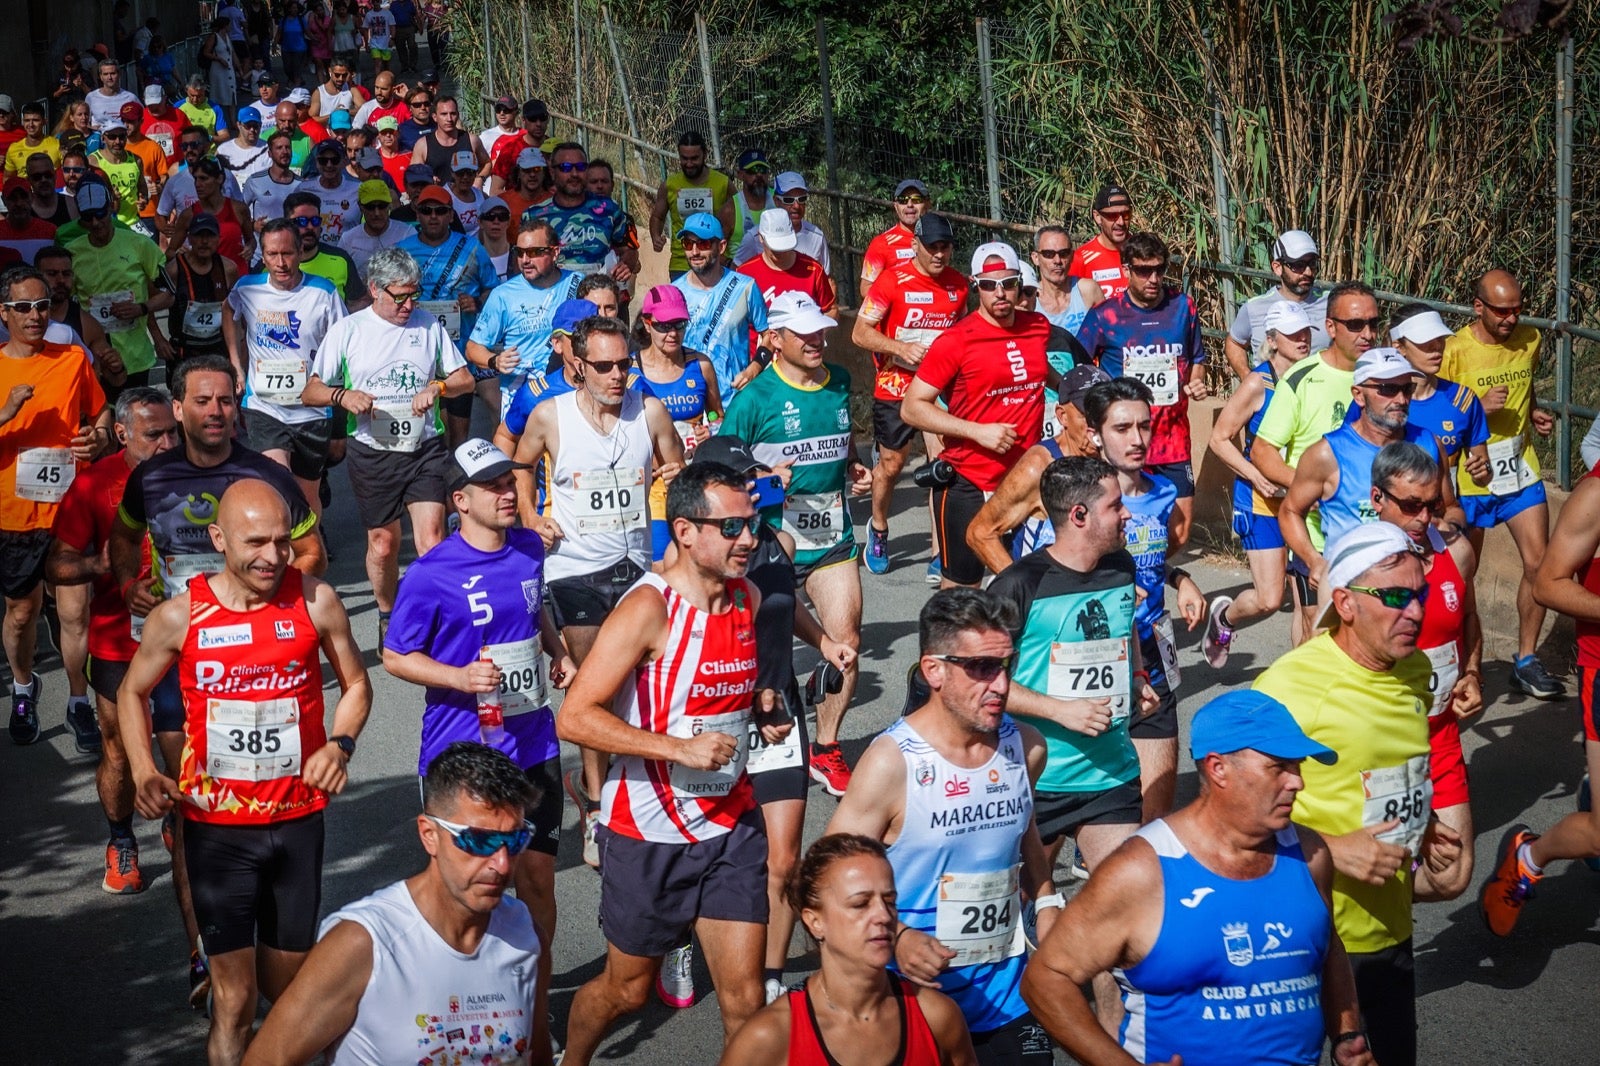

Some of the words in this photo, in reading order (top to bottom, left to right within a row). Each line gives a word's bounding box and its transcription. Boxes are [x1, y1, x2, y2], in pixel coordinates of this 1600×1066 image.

[684, 199, 705, 209] 562
[197, 313, 213, 325] 42
[904, 308, 953, 328] Polisalu
[266, 374, 295, 389] 773
[1477, 369, 1532, 389] agustinos
[662, 394, 700, 407] stinos
[389, 421, 412, 436] 89
[782, 442, 814, 456] CAJA
[798, 450, 839, 462] GRANADA
[37, 466, 61, 484] 45
[590, 489, 631, 511] 810
[797, 511, 832, 530] 586
[467, 591, 494, 627] 5
[196, 660, 308, 694] Polisalud
[1069, 665, 1114, 691] 726
[228, 728, 282, 755] 385
[687, 783, 735, 794] DEPORT
[930, 797, 1025, 829] MARACENA
[1383, 789, 1423, 824] 856
[945, 827, 967, 837] CLUB
[977, 819, 1018, 832] ATLETISMO
[960, 899, 1012, 935] 284
[1202, 985, 1247, 1001] CLUB
[1249, 974, 1319, 998] ATLETISM
[466, 992, 506, 1005] ALMERÍA
